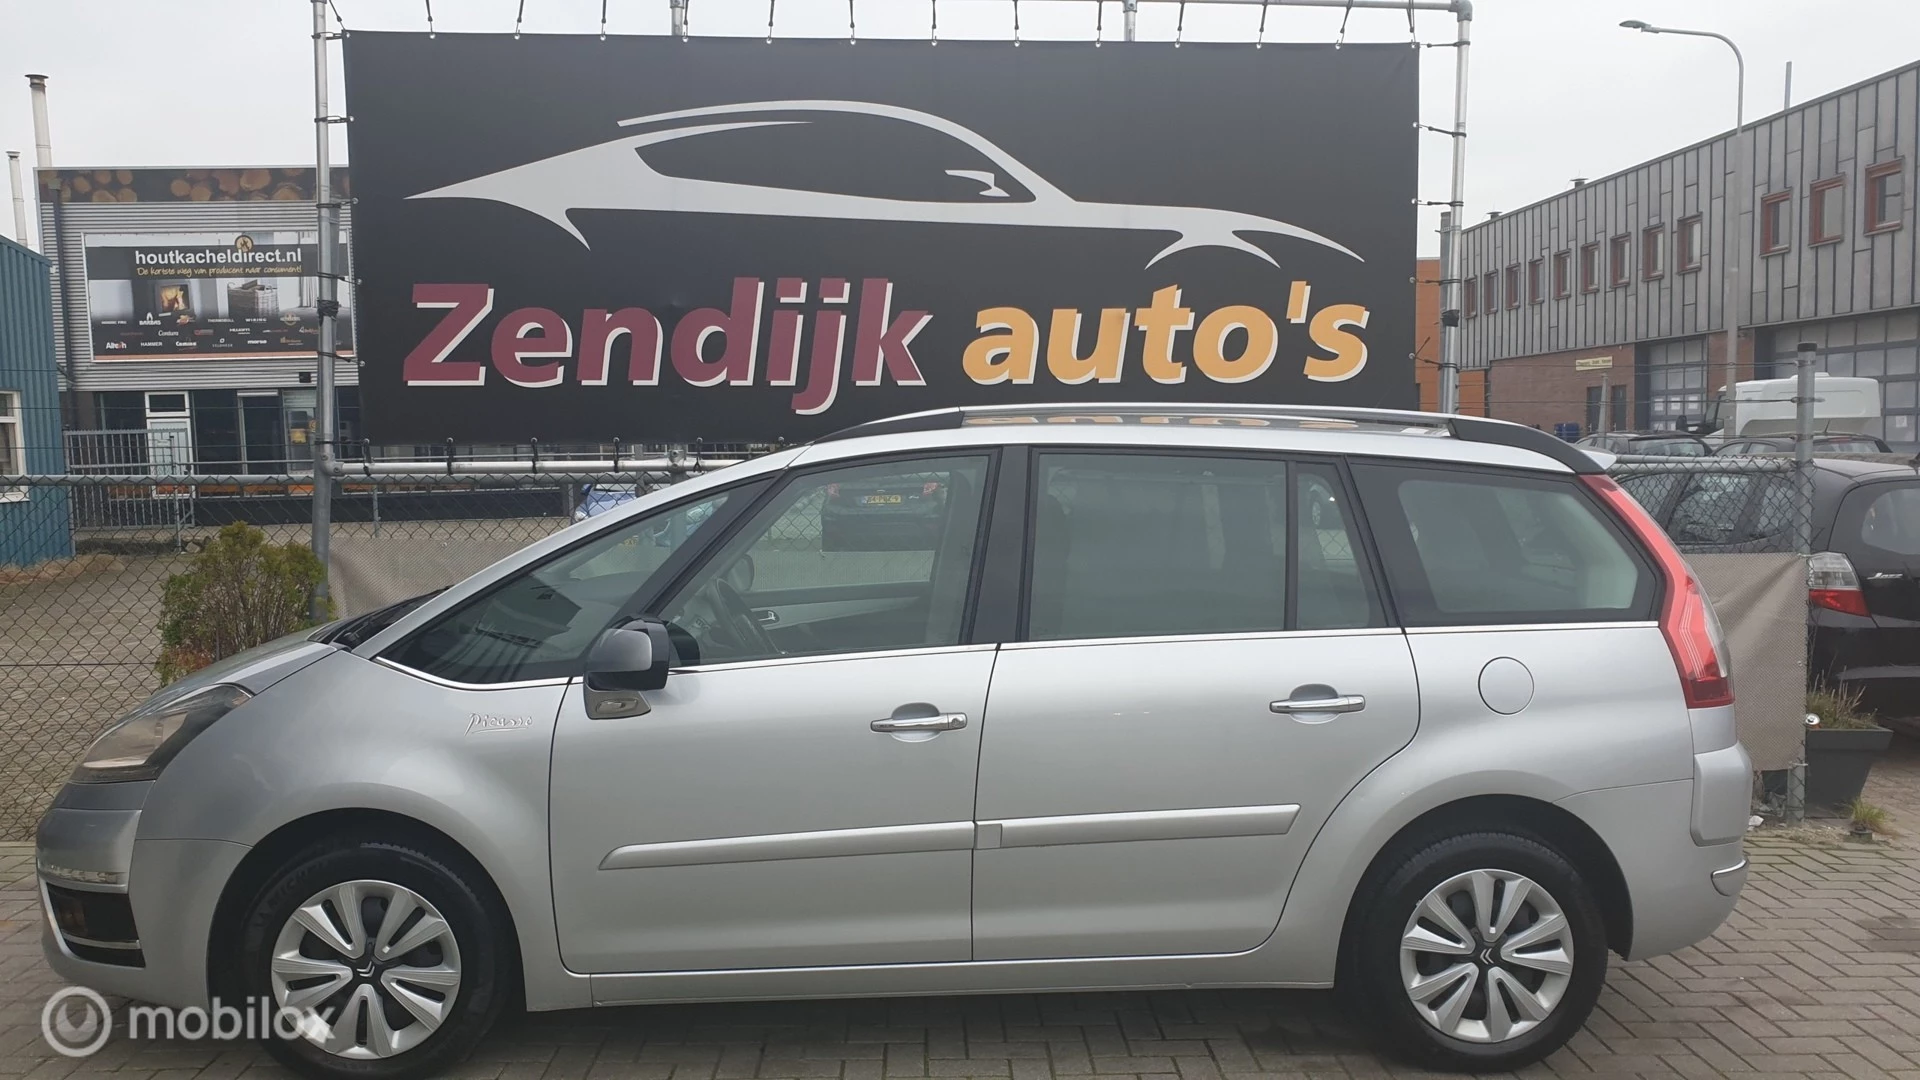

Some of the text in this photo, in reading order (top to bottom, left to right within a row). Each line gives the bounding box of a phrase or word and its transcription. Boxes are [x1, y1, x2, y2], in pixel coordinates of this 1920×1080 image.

[135, 248, 302, 264] houtkacheldirect.nl
[137, 267, 149, 275] De
[177, 268, 192, 277] weg
[208, 266, 244, 277] producent
[245, 266, 260, 274] naar
[403, 277, 1370, 415] Zendijk auto's
[464, 713, 533, 736] Picasso
